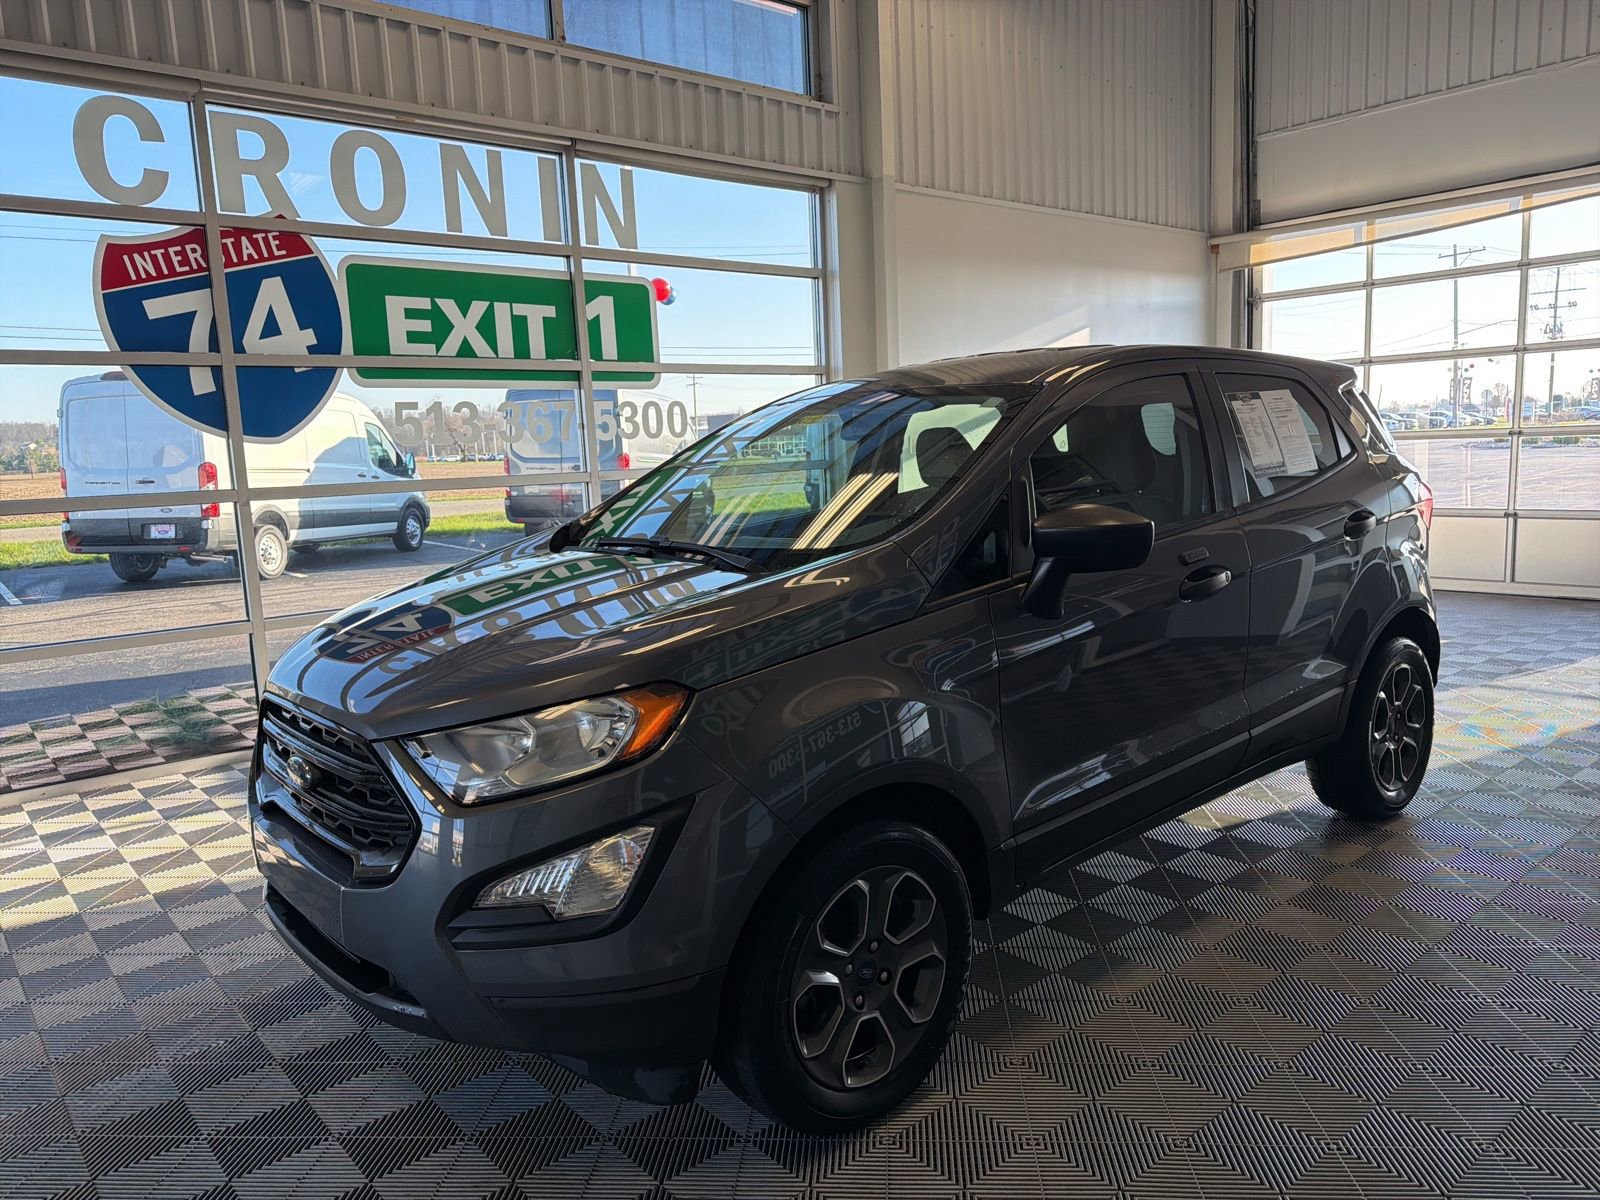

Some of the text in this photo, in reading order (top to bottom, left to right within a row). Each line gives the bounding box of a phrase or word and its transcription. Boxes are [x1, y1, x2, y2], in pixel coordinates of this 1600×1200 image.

[72, 94, 637, 249] CRONIN
[122, 231, 287, 281] INTERTATE
[141, 276, 318, 397] 74
[384, 294, 619, 361] EXIT 1
